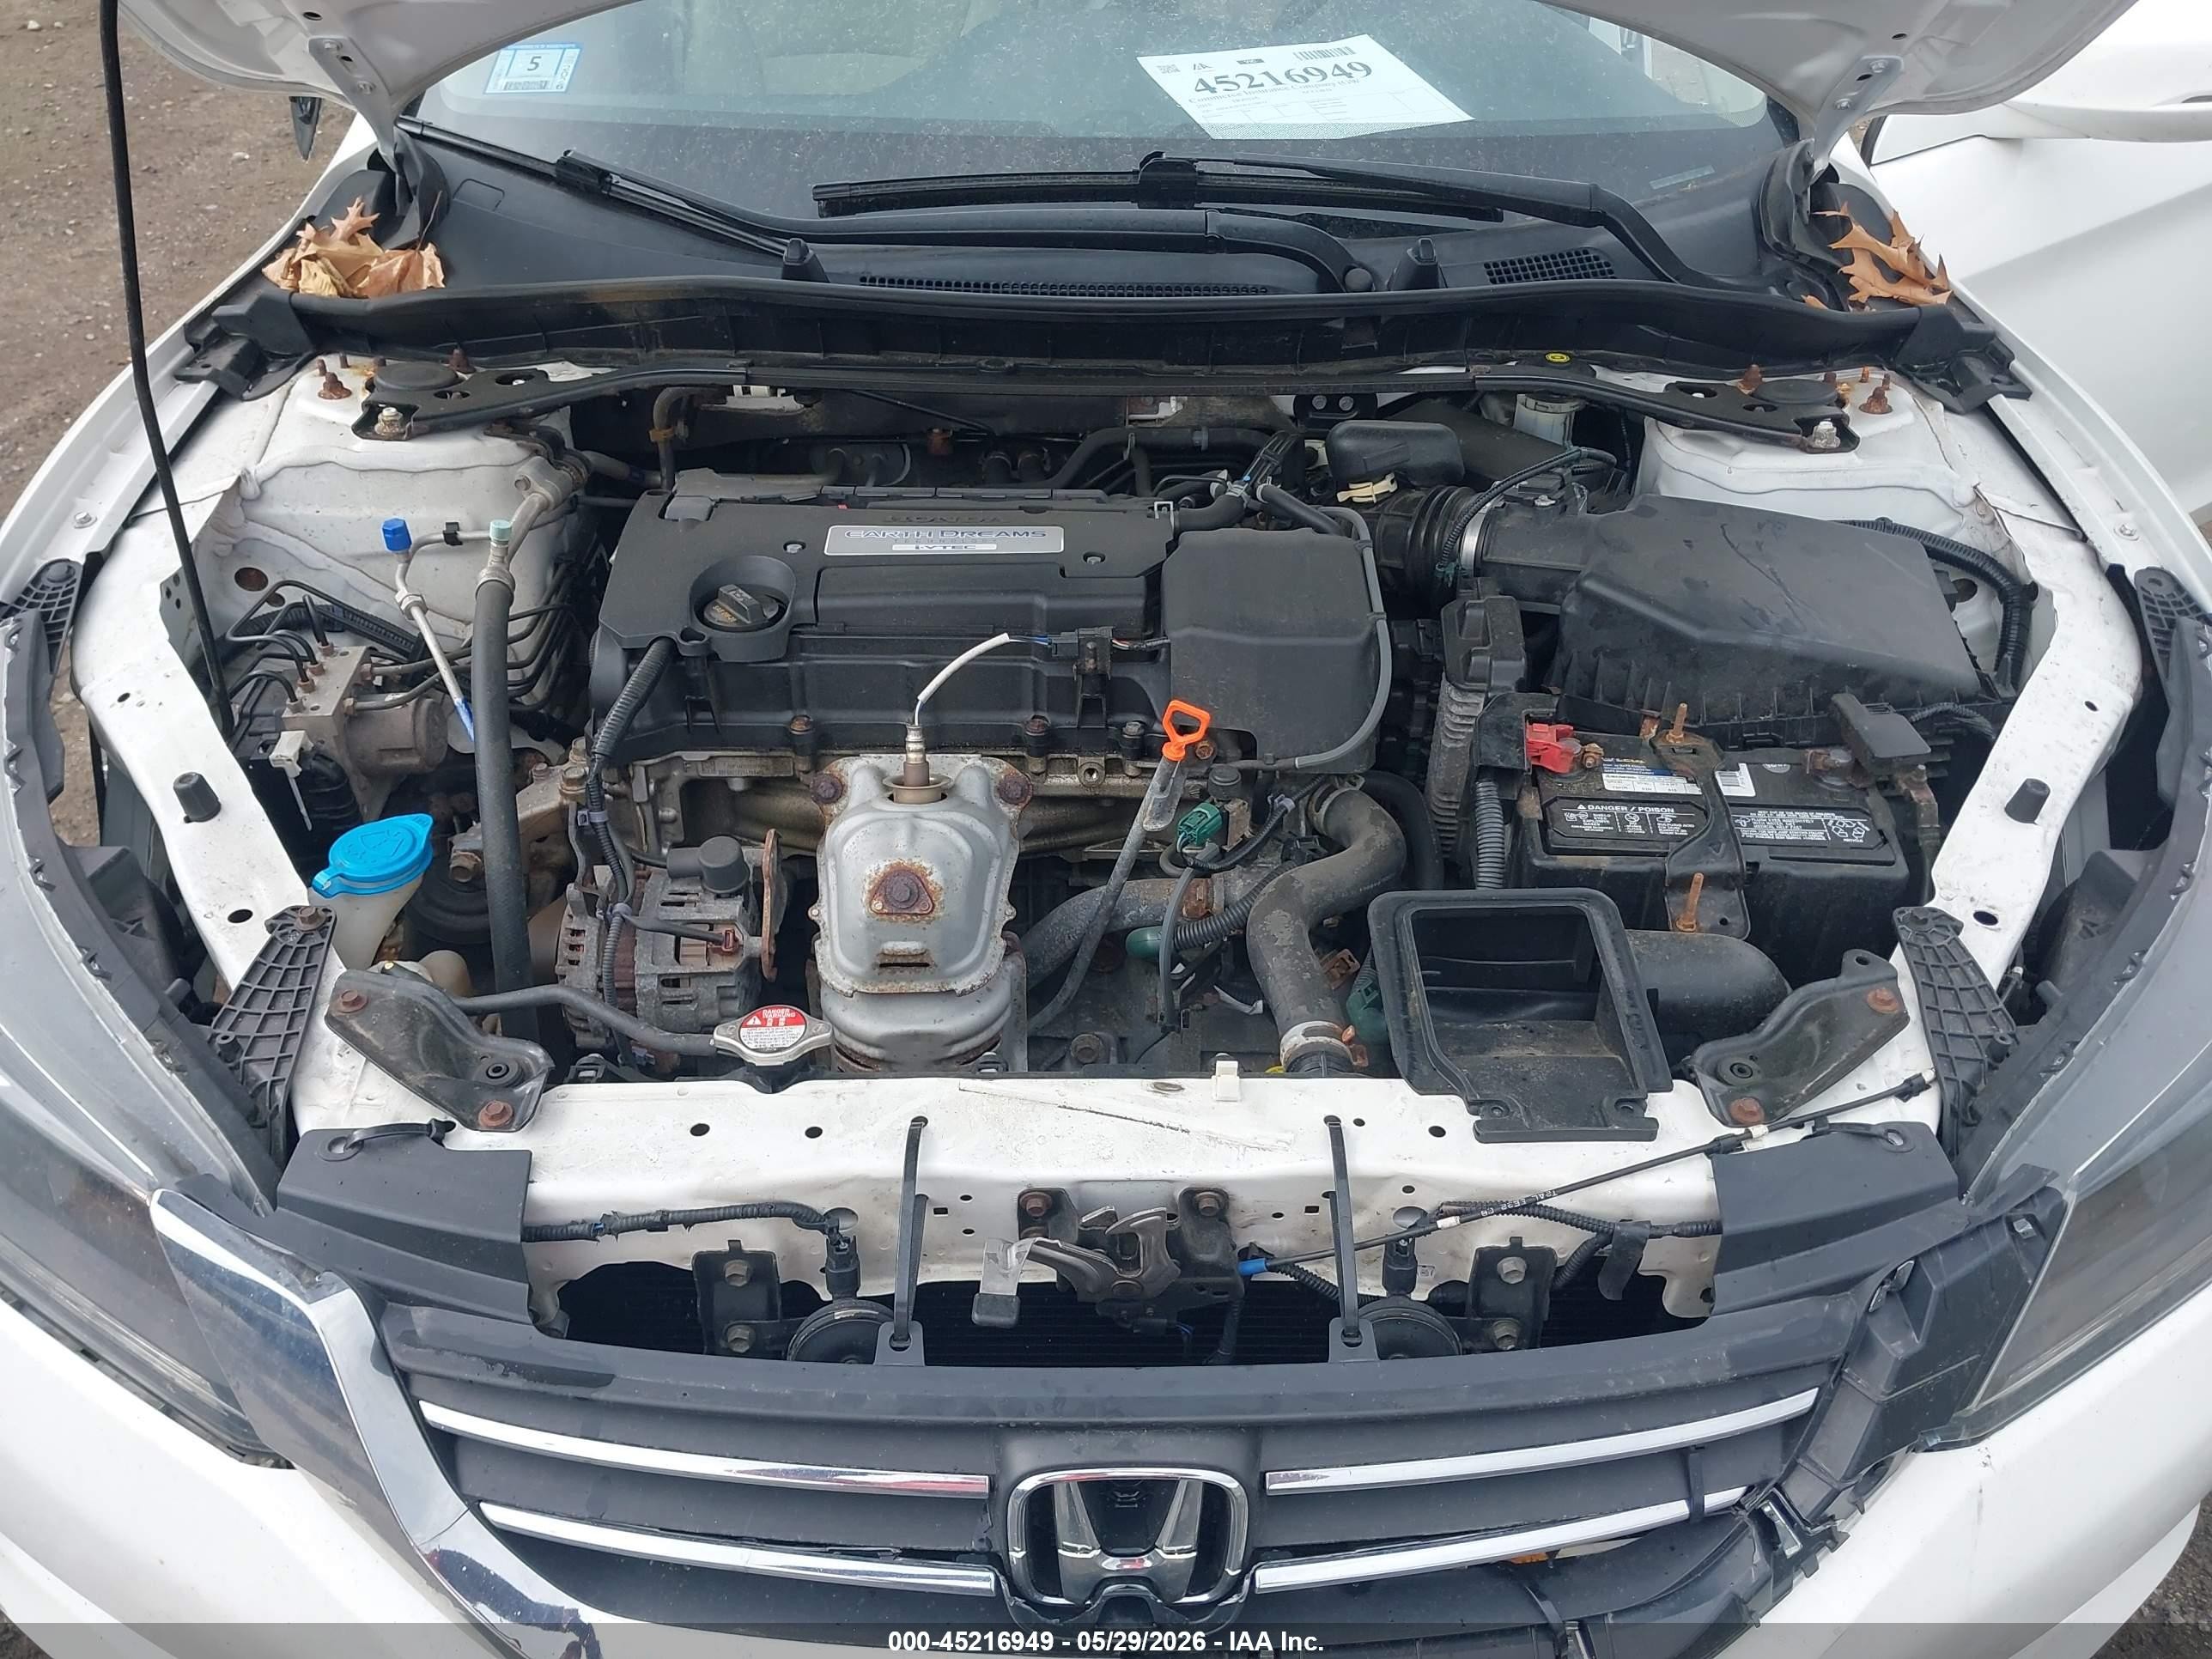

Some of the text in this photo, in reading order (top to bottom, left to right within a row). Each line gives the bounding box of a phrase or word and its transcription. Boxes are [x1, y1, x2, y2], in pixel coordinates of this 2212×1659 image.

[526, 56, 542, 71] 5
[1194, 61, 1373, 94] 45216949
[845, 529, 1047, 538] EARTH DREAMS
